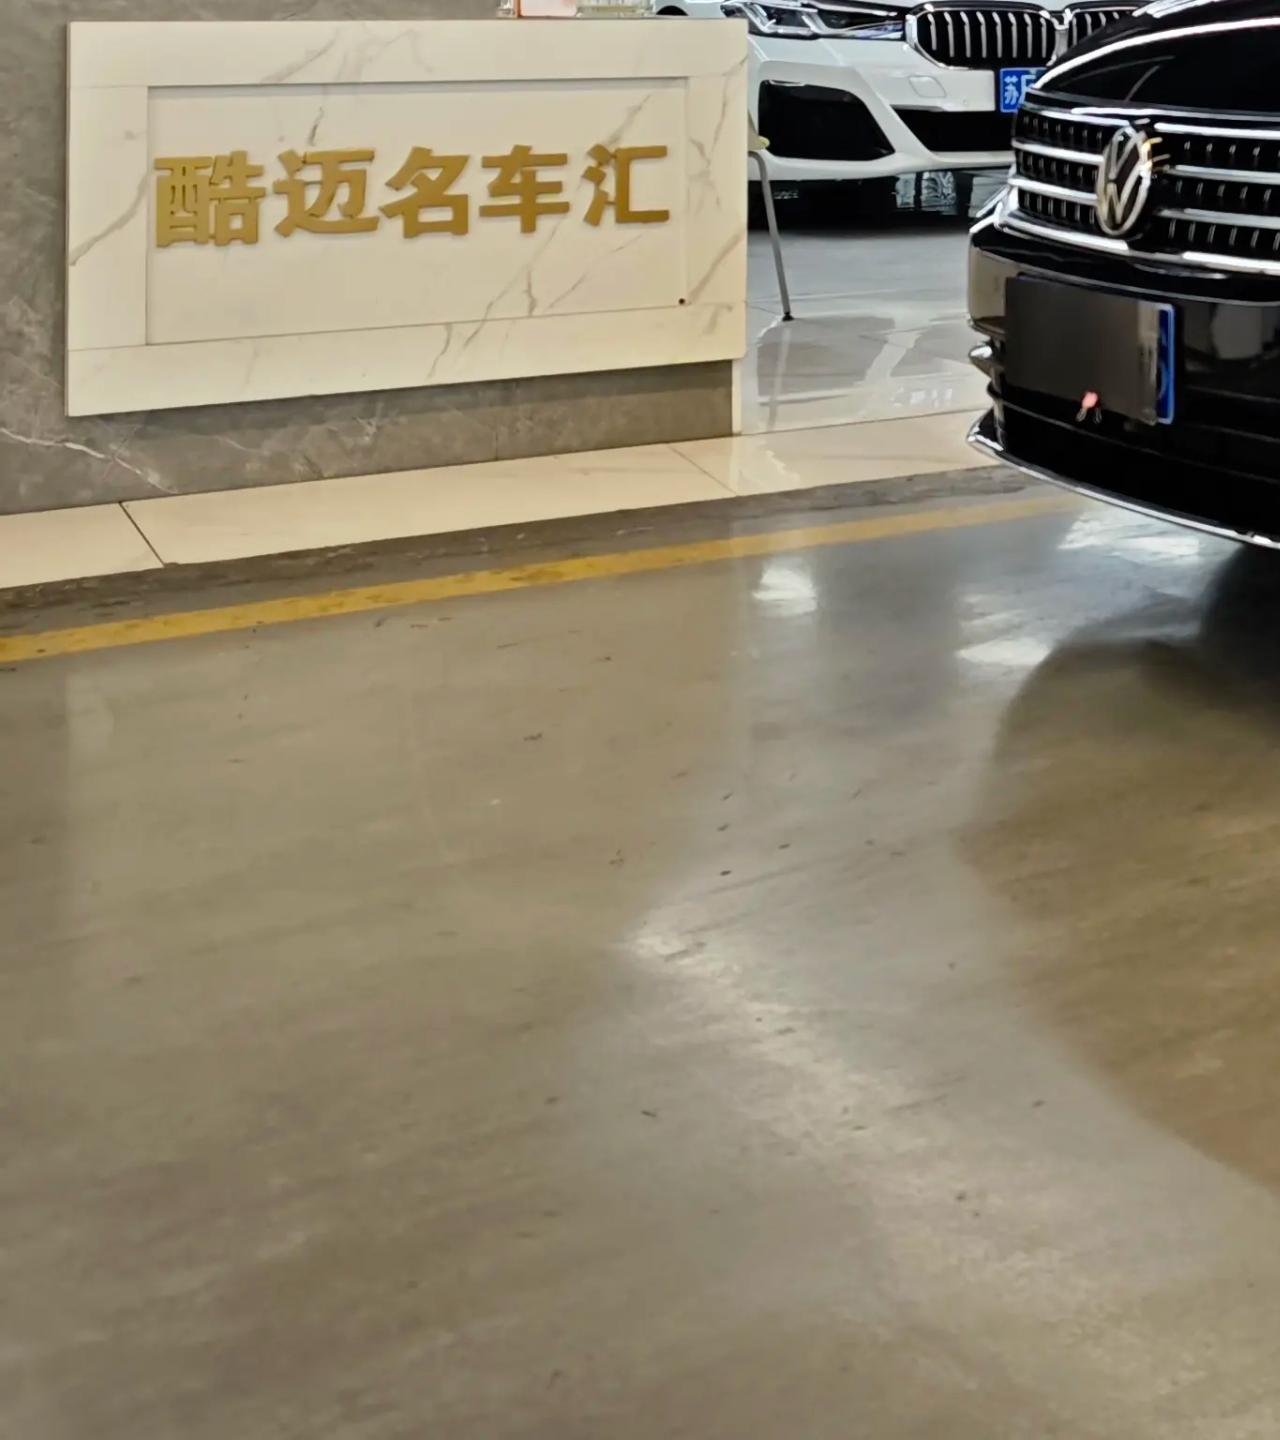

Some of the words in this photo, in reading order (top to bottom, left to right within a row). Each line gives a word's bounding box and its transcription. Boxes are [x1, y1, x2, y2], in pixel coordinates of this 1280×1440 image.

[153, 144, 670, 247] 酷迈名车汇
